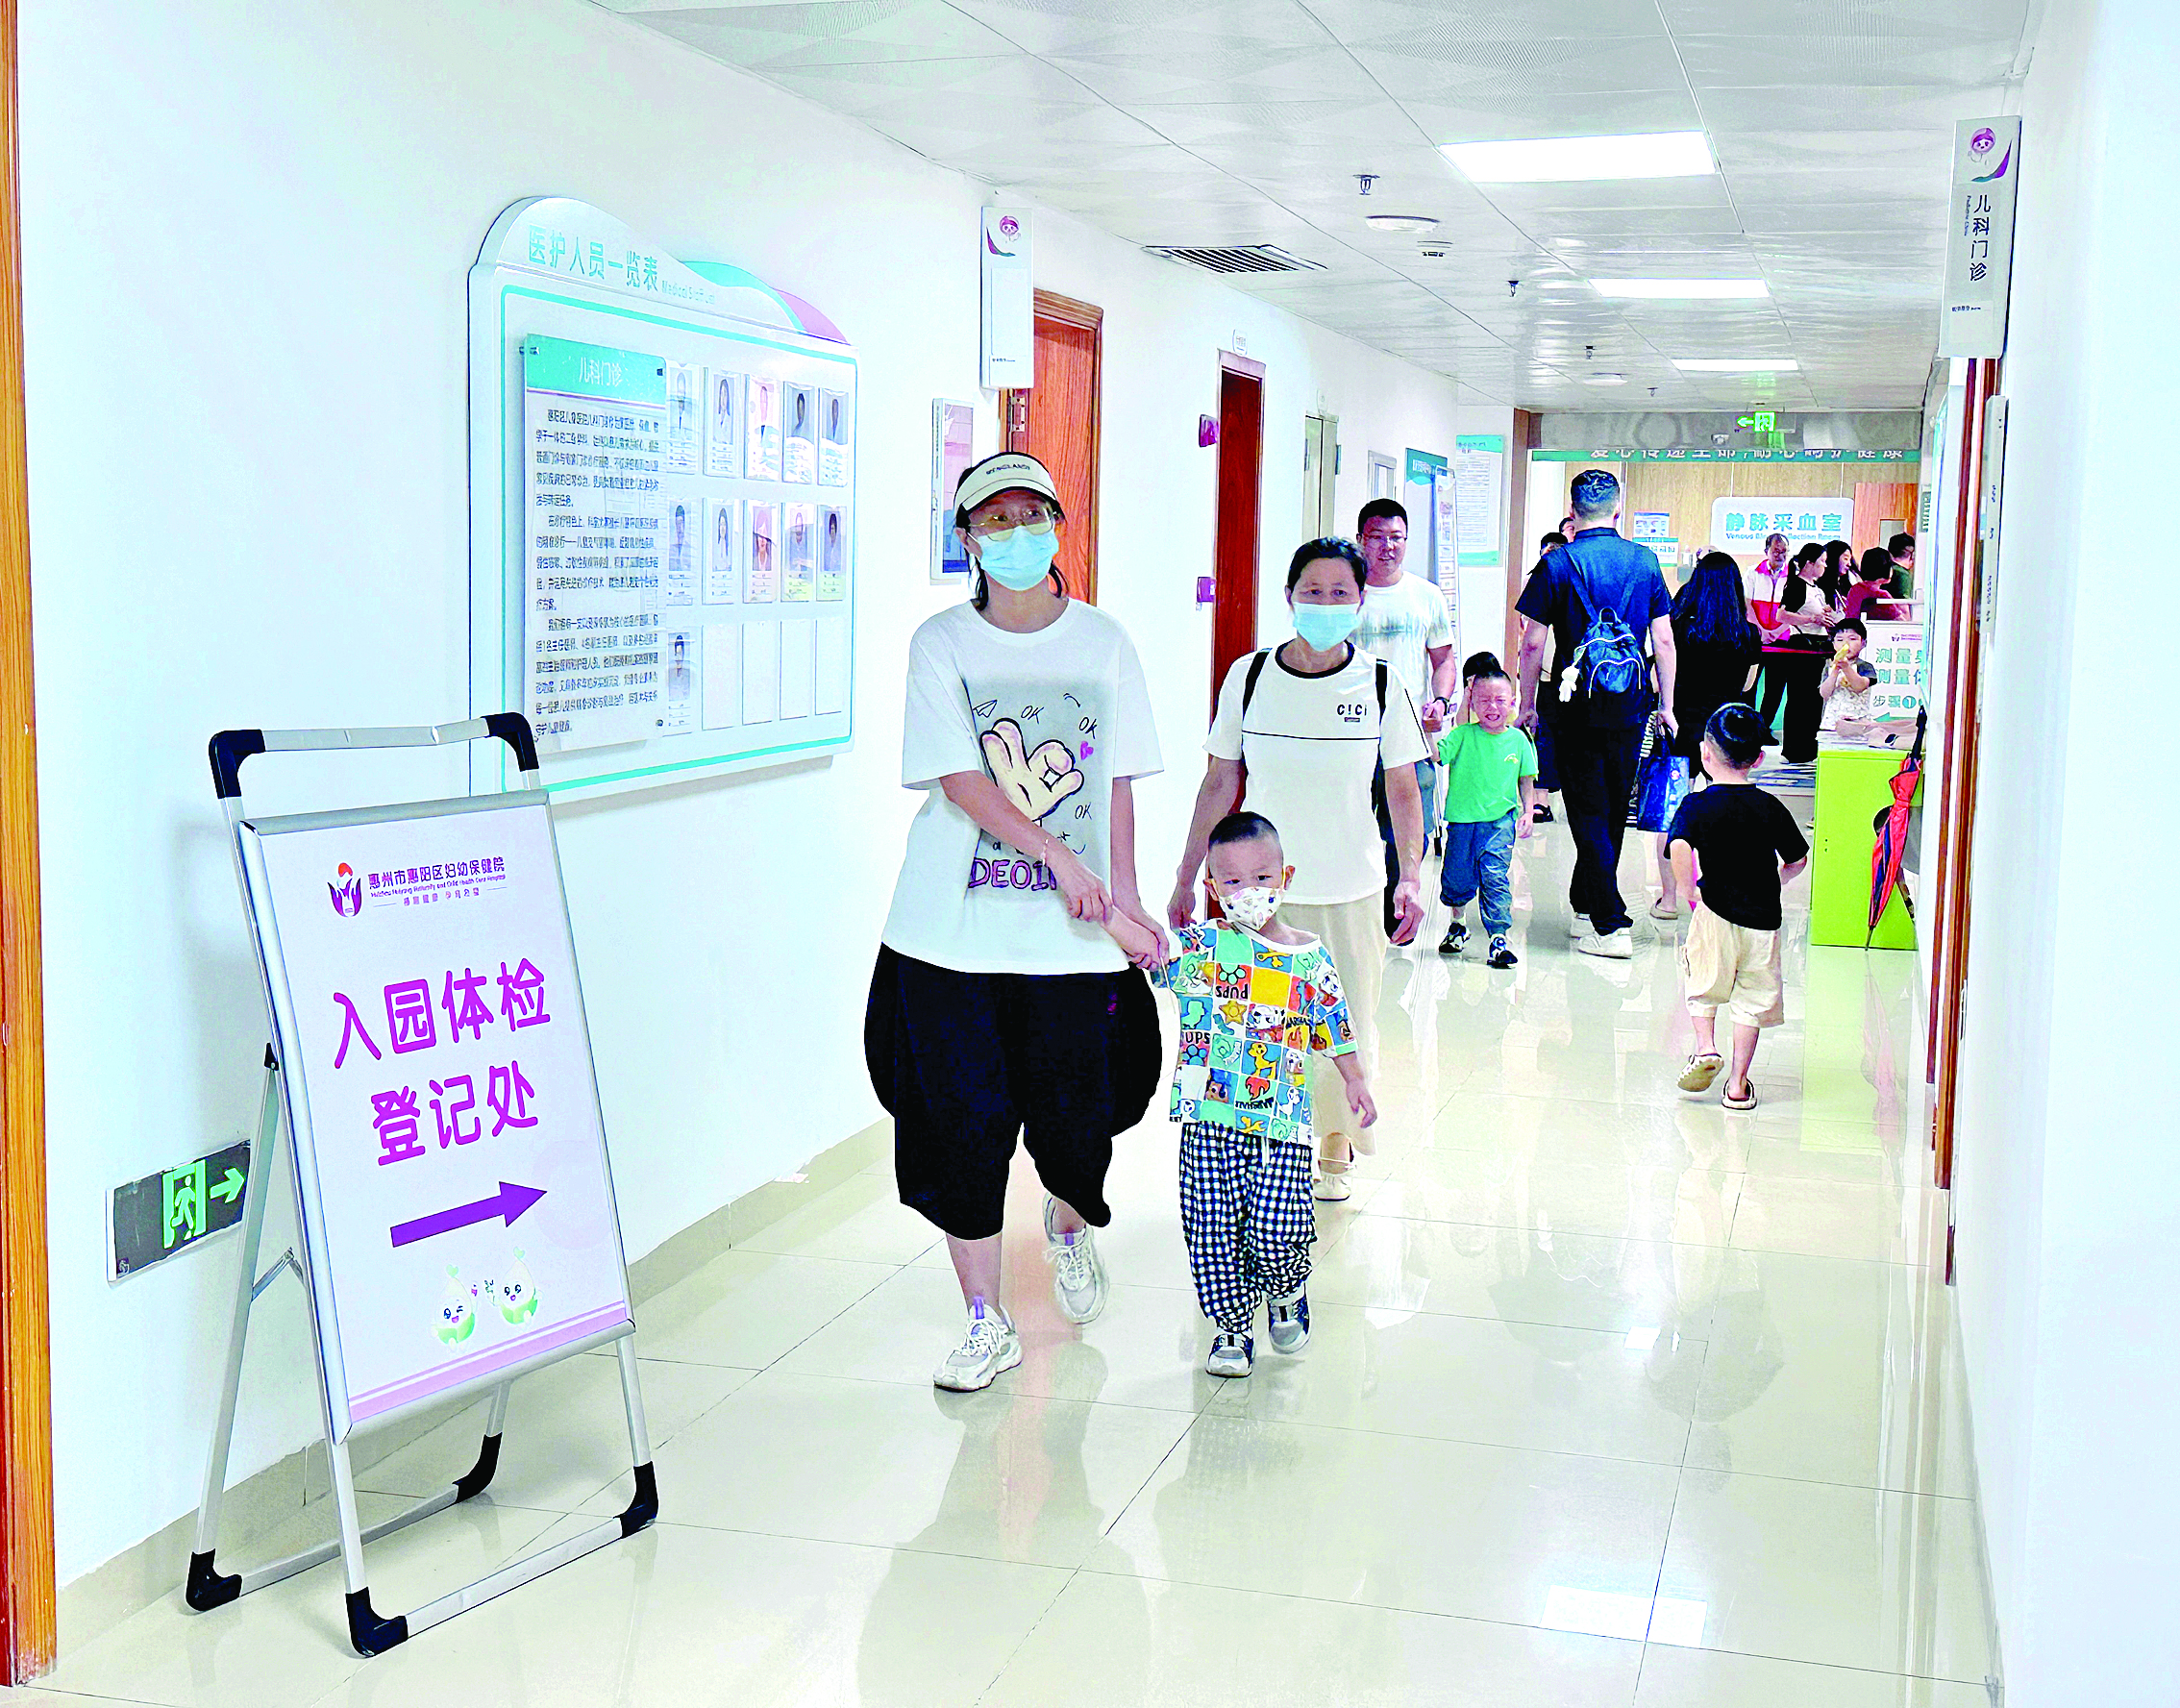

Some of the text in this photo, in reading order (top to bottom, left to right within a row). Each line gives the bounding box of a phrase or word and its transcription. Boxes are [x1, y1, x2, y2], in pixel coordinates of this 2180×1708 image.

[1969, 194, 1991, 282] 儿科门诊
[529, 224, 658, 291] 医护人员一览表
[579, 357, 623, 387] 儿科门诊
[1725, 512, 1843, 532] 静脉采血室
[1021, 705, 1044, 725] OK
[1078, 716, 1098, 739] OK
[1075, 802, 1092, 820] OK
[367, 856, 506, 890] 惠州市惠阳区妇幼保健院
[1215, 983, 1249, 1000] PUPS
[334, 957, 551, 1070] 入园体检
[371, 1060, 538, 1166] 登记处
